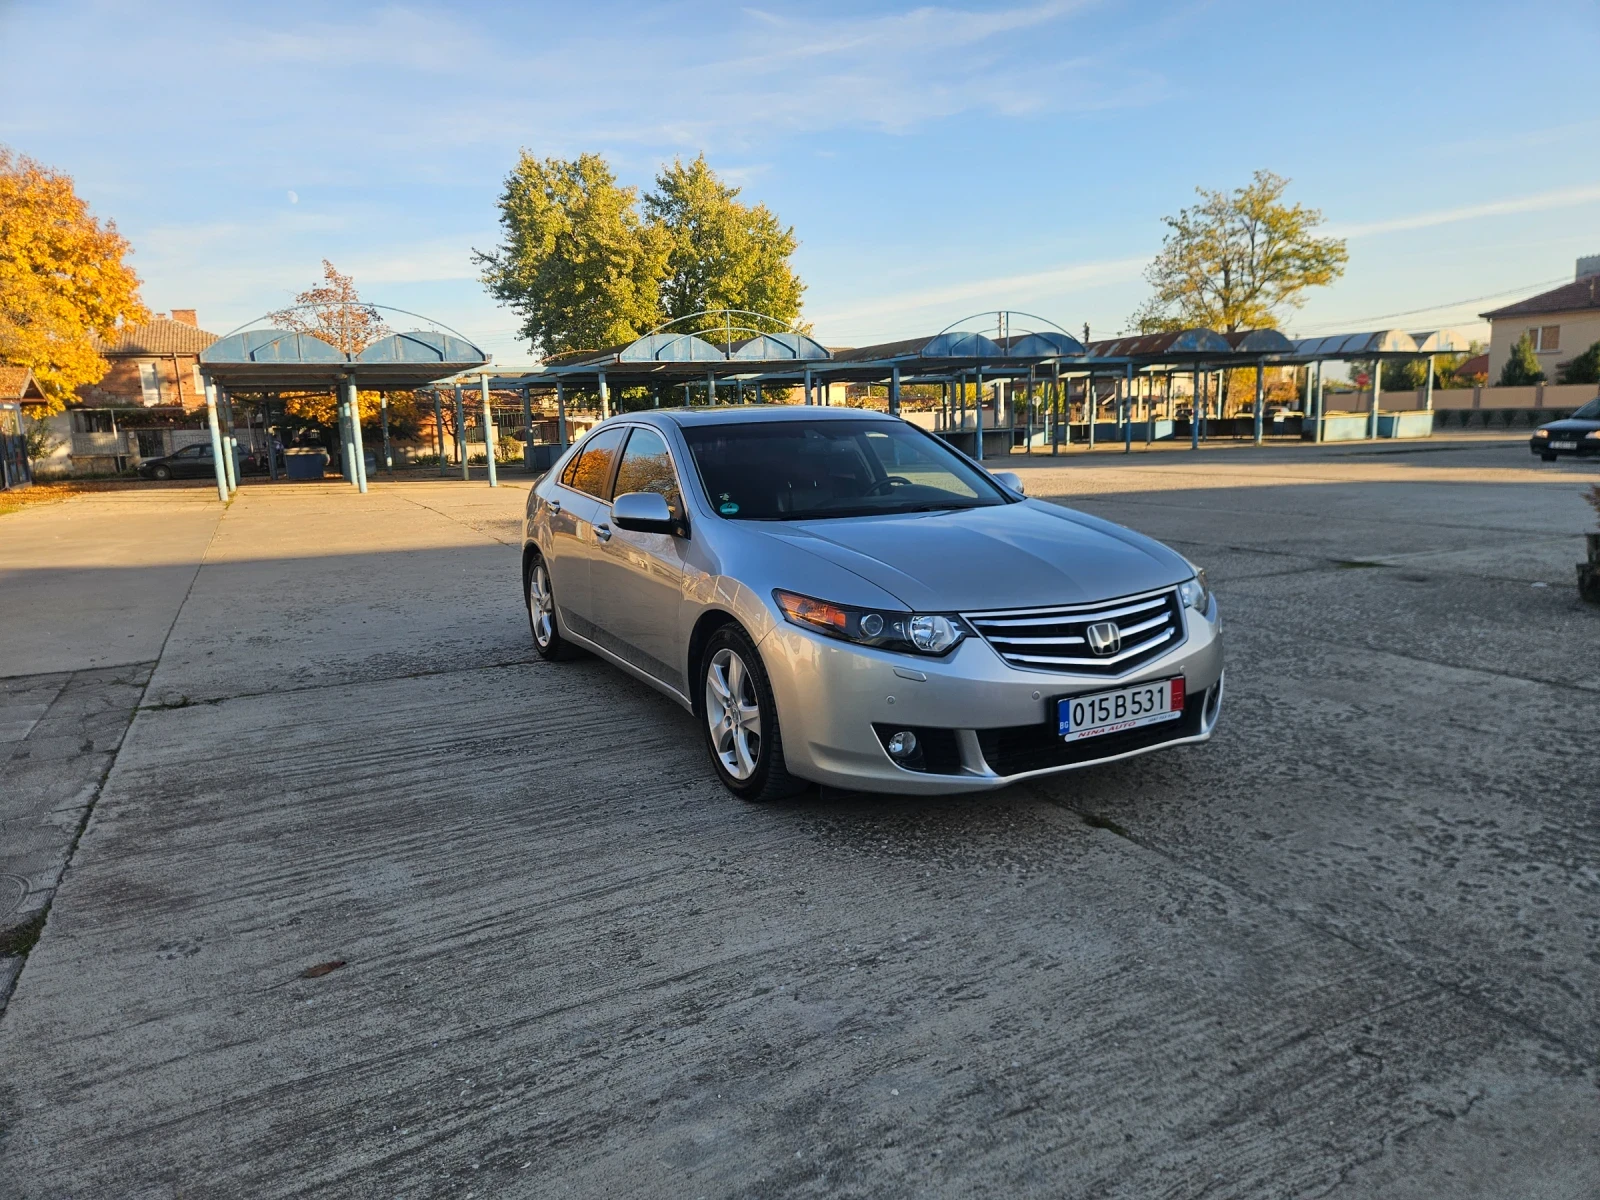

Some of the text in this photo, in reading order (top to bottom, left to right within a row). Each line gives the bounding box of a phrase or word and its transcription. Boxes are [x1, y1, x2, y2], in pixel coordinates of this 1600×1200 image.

[1060, 686, 1164, 730] BG 015B531
[1078, 721, 1137, 738] NINA AUTO
